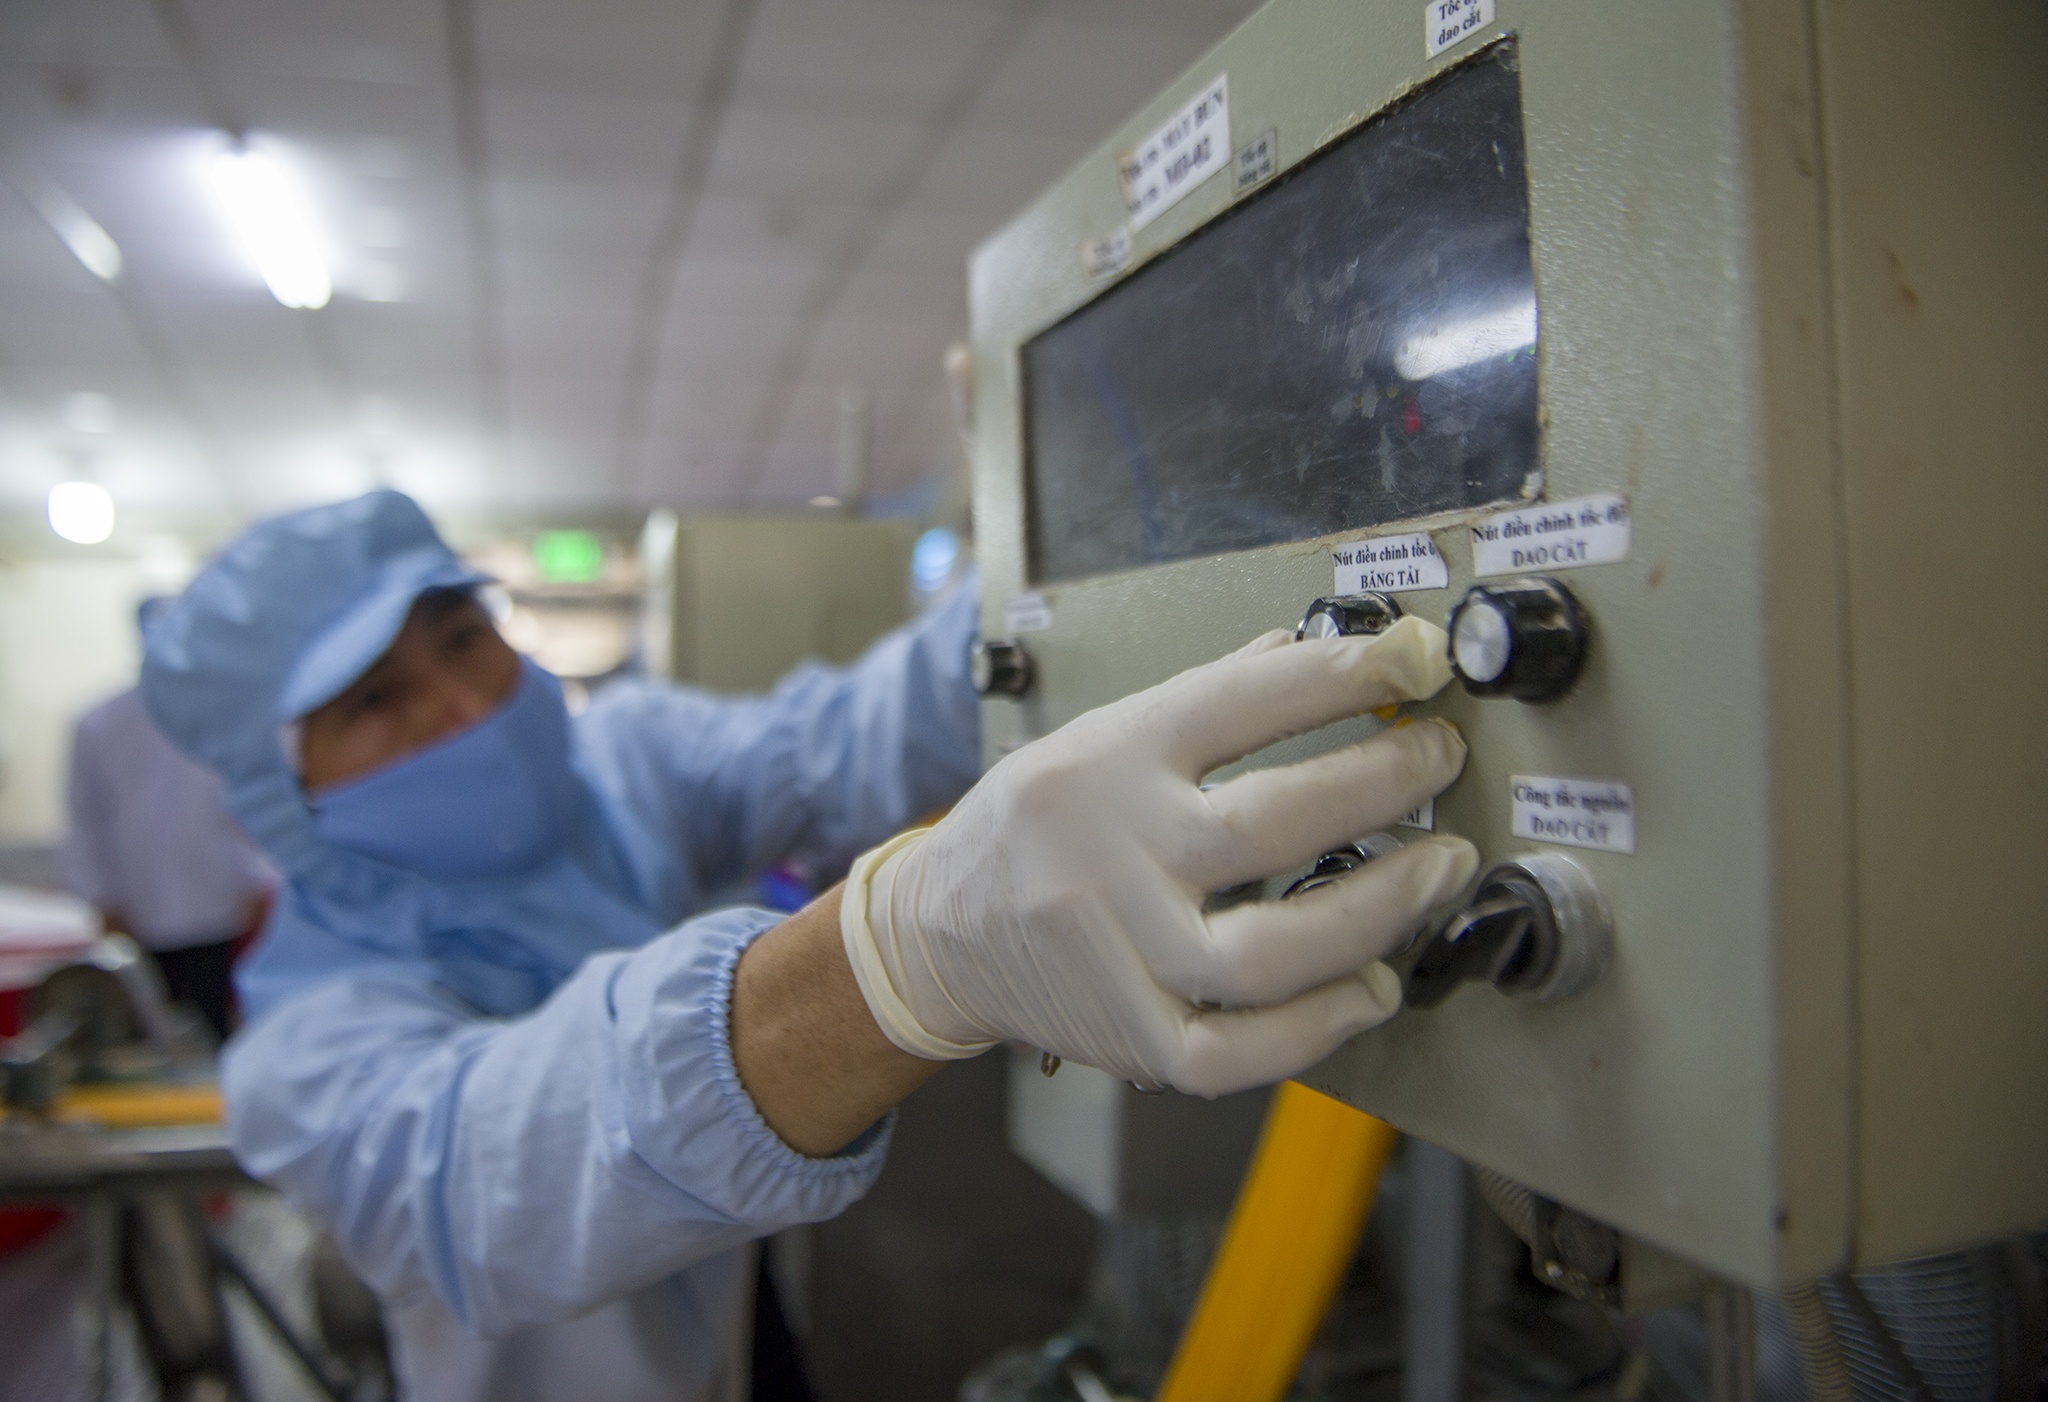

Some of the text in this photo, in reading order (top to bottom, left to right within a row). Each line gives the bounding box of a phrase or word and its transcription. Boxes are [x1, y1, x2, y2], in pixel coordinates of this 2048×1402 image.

[1438, 6, 1481, 45] dao cắt
[1471, 525, 1499, 544] Nút
[1503, 515, 1532, 539] điều
[1333, 551, 1353, 567] Nút
[1355, 545, 1377, 564] điều
[1380, 544, 1409, 561] chỉnh
[1411, 537, 1427, 558] tốc
[1512, 538, 1589, 568] DAO CẮT
[1361, 565, 1420, 589] BĂNG TẢI
[1514, 784, 1552, 810] Công
[1530, 815, 1570, 838] DAO
